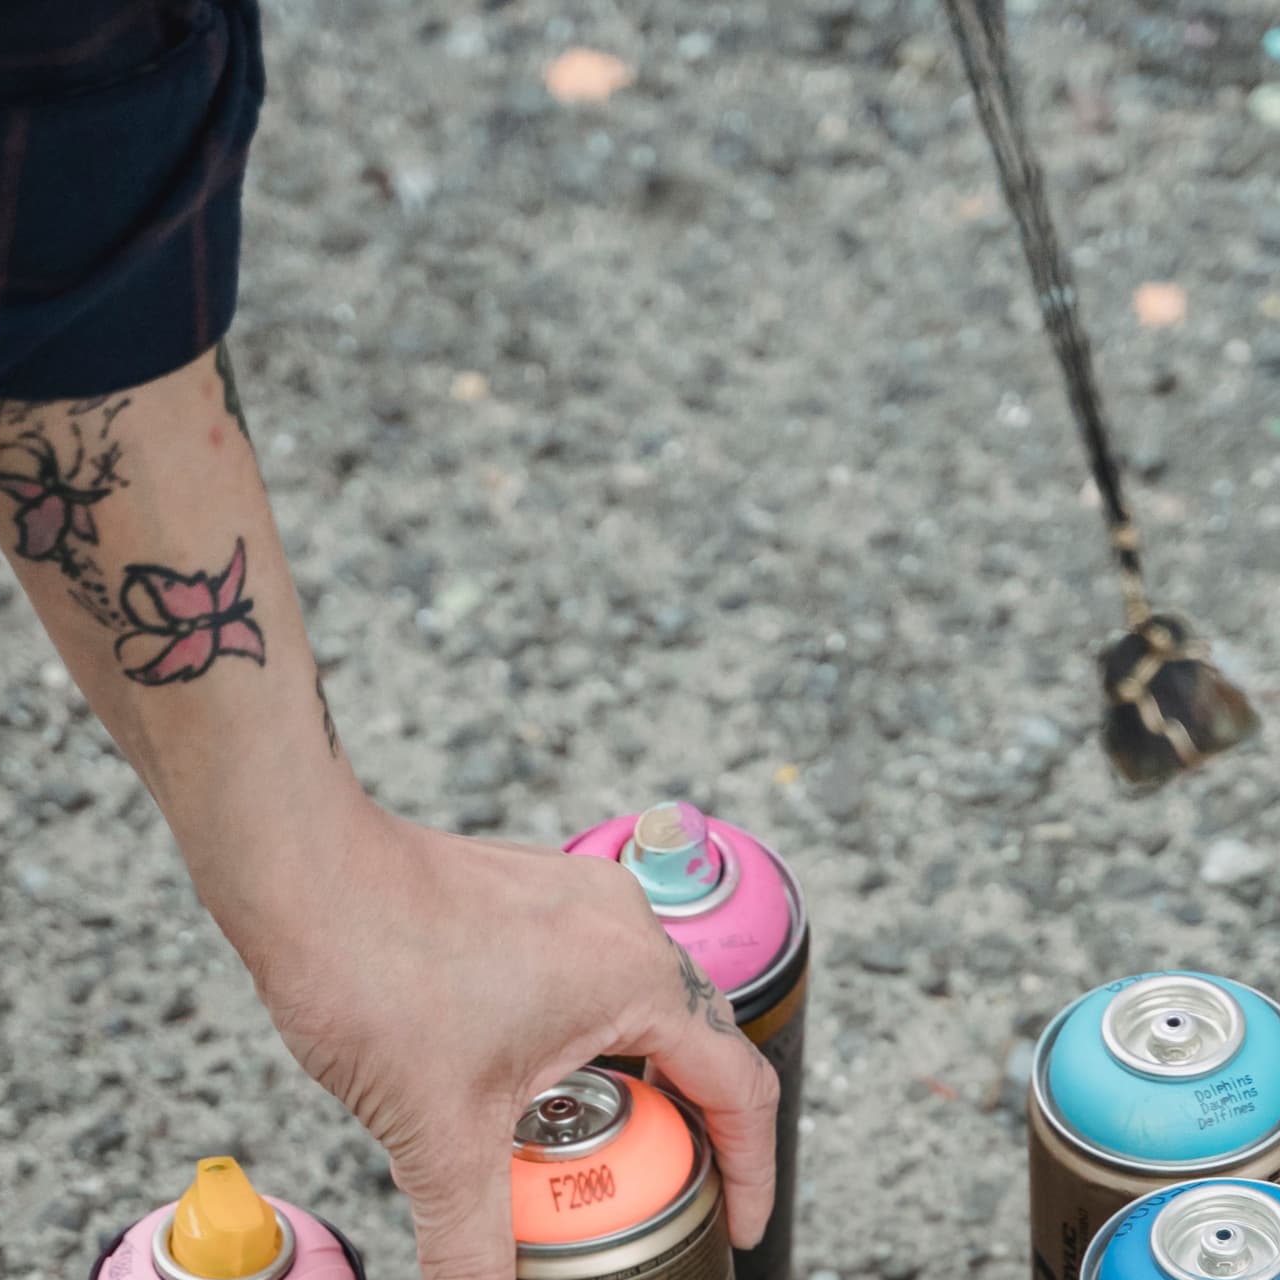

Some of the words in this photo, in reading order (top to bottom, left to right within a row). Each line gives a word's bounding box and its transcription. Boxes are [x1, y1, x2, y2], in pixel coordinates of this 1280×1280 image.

[1194, 1073, 1253, 1103] Dolphins
[1200, 1086, 1259, 1115] Dauphins
[1198, 1101, 1256, 1130] Delfines
[549, 1164, 616, 1212] F2000
